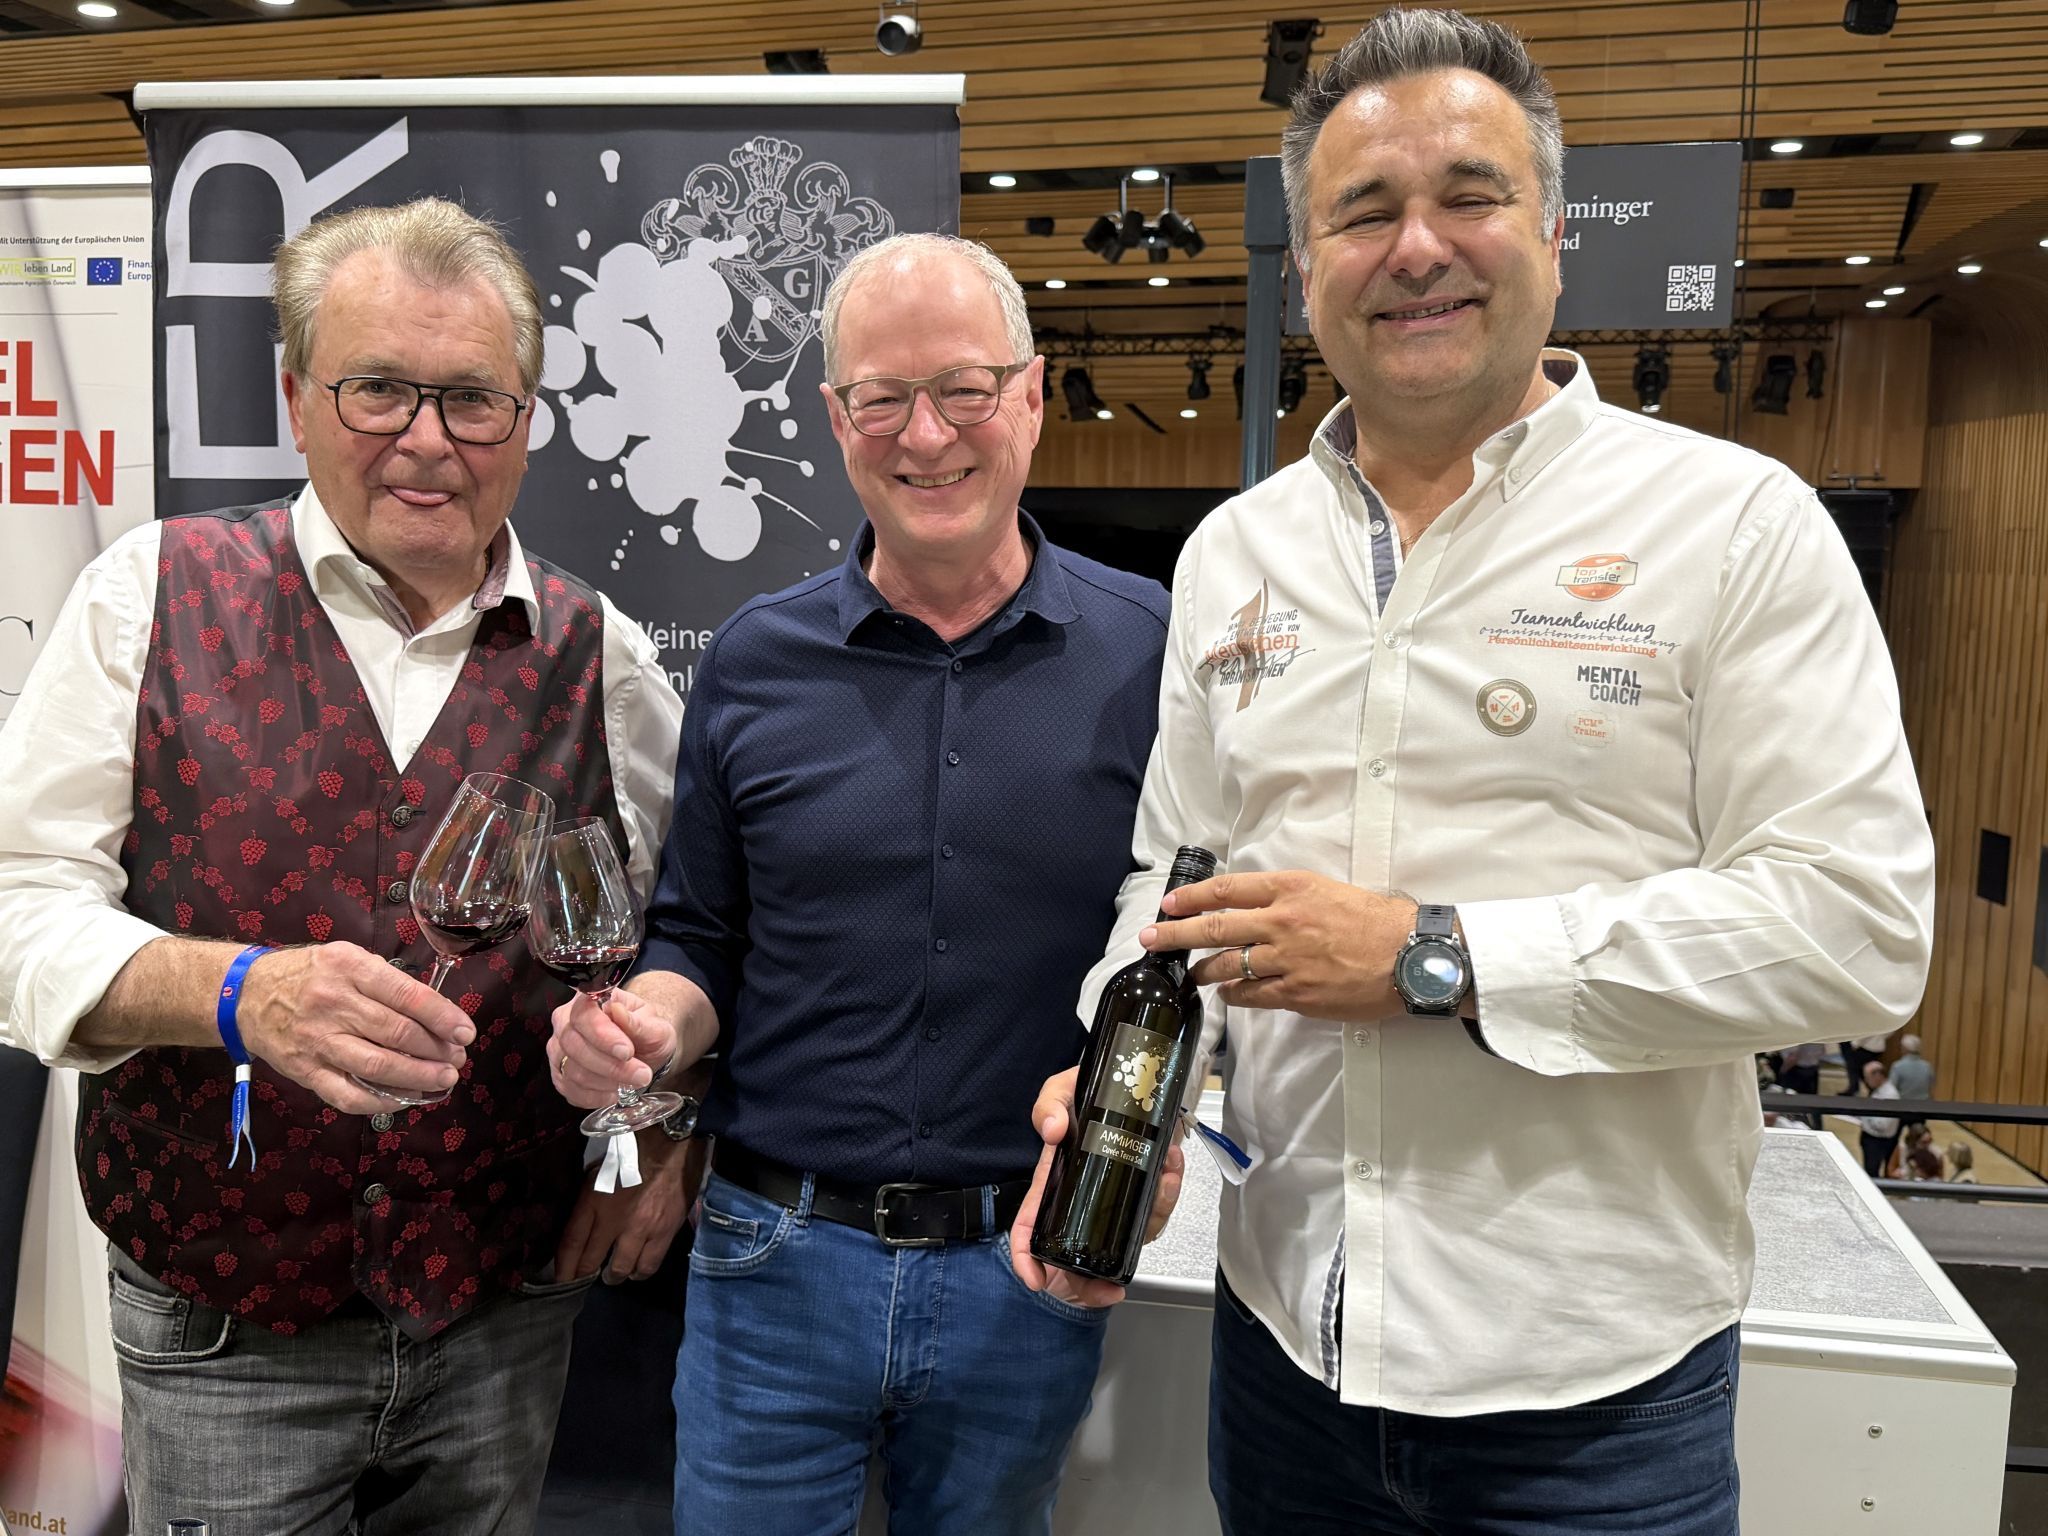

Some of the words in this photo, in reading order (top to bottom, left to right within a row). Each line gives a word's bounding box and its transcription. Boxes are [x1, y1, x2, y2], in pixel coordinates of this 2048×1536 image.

[61, 236, 73, 244] der
[75, 235, 121, 244] Europäischen
[123, 235, 145, 243] Union
[24, 262, 48, 272] leben
[51, 263, 73, 272] Land
[0, 341, 58, 416] L
[0, 430, 115, 505] EN
[1511, 608, 1656, 638] Teamentwicklung
[1577, 665, 1642, 688] MENTAL
[1590, 684, 1641, 706] COACH
